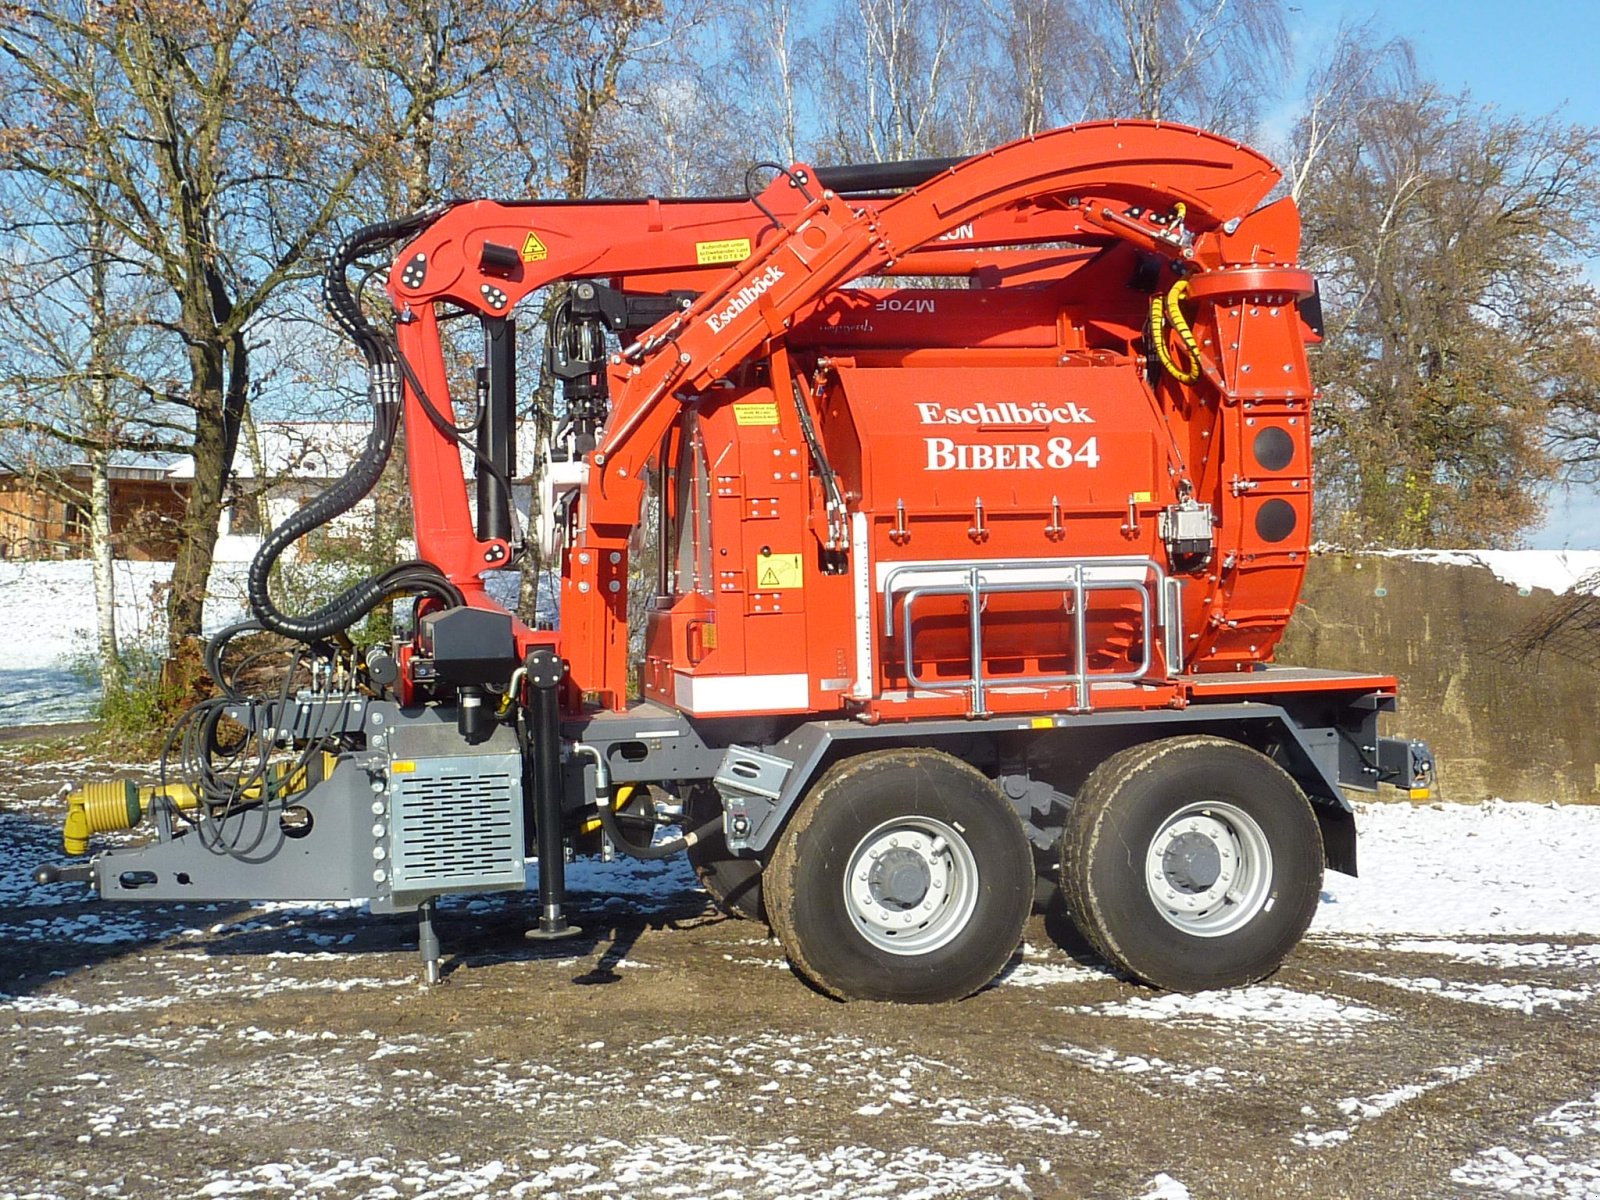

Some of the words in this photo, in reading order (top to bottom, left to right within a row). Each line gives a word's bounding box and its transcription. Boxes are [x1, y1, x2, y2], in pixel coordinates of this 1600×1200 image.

[704, 265, 785, 335] Eschlböck
[876, 300, 935, 312] M70F
[914, 402, 1096, 424] Eschlböck
[922, 437, 1044, 470] BIBER
[1047, 436, 1100, 469] 84
